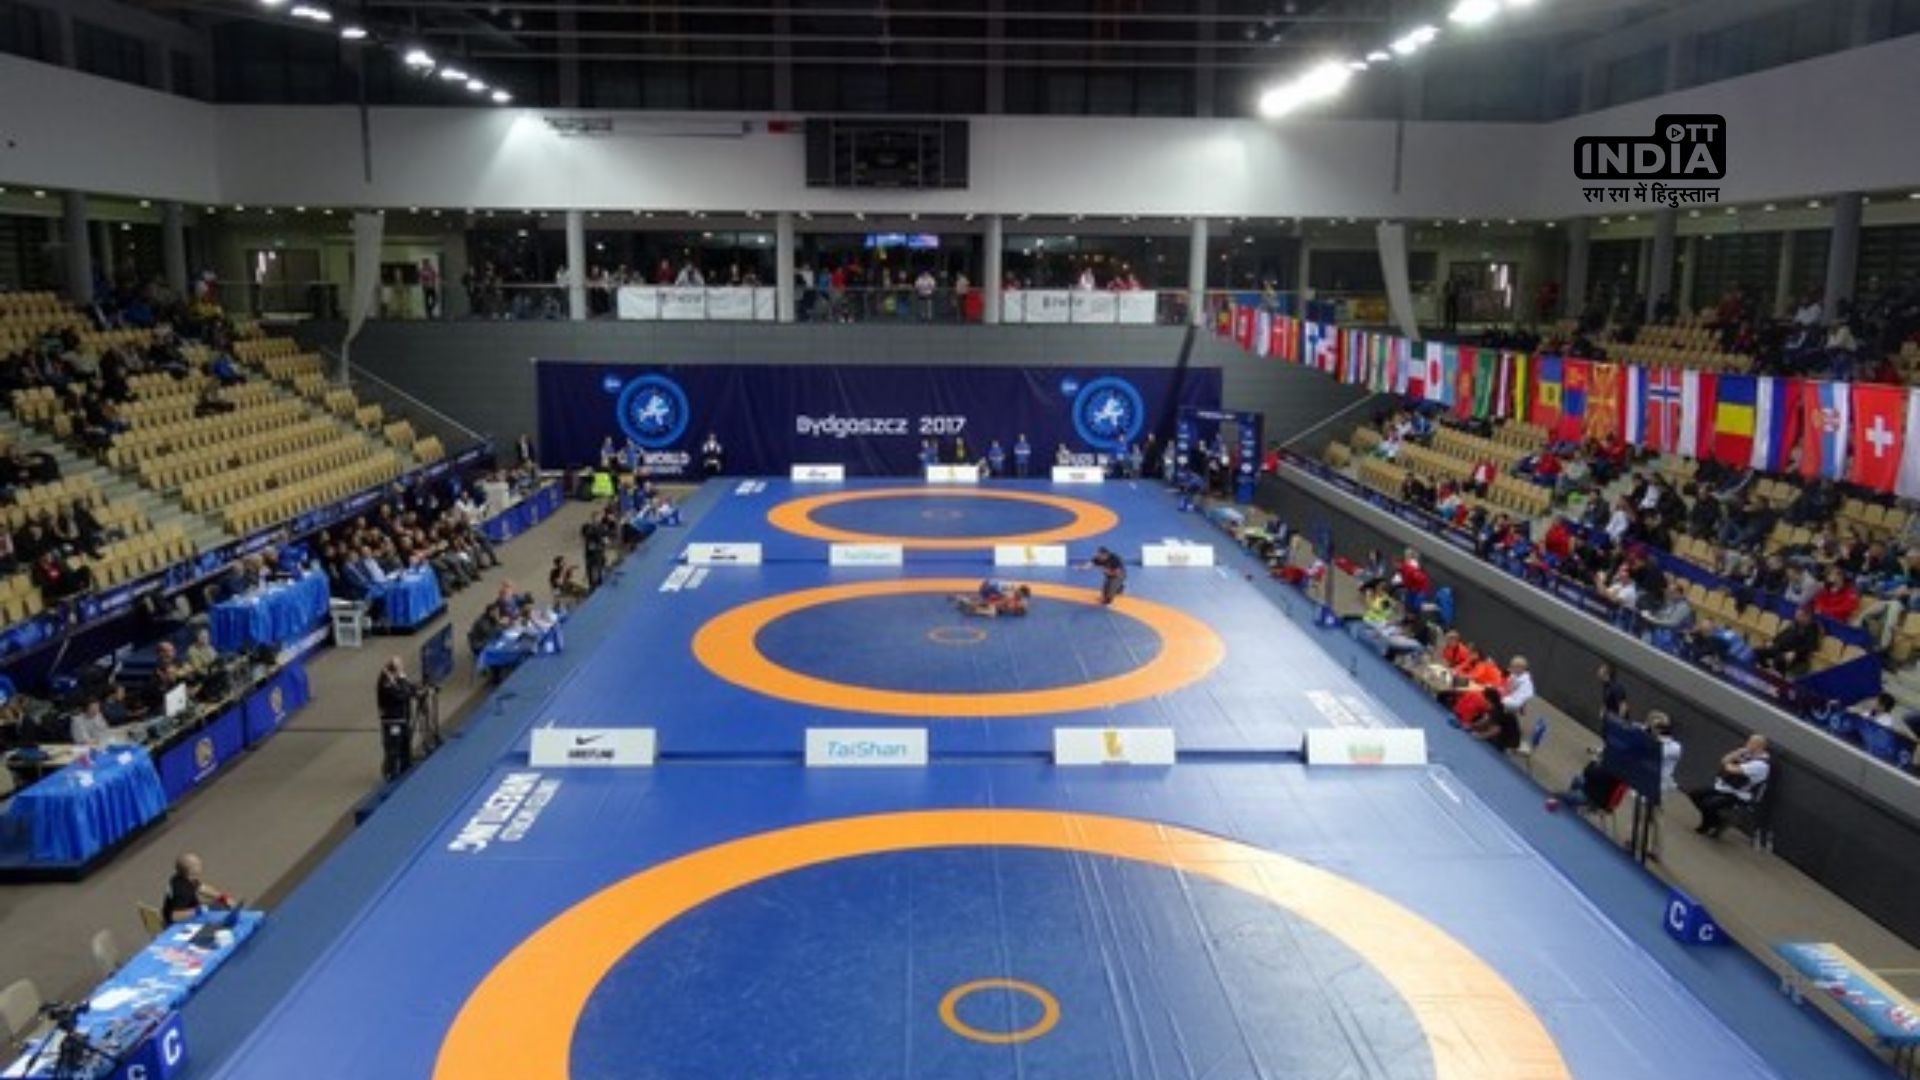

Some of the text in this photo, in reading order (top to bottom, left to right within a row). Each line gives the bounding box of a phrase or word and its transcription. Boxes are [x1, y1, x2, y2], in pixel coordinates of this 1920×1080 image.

[796, 414, 967, 438] Bydgoszcz 2017
[827, 740, 908, 759] TaiShan
[1669, 900, 1688, 931] C
[162, 1027, 182, 1066] C
